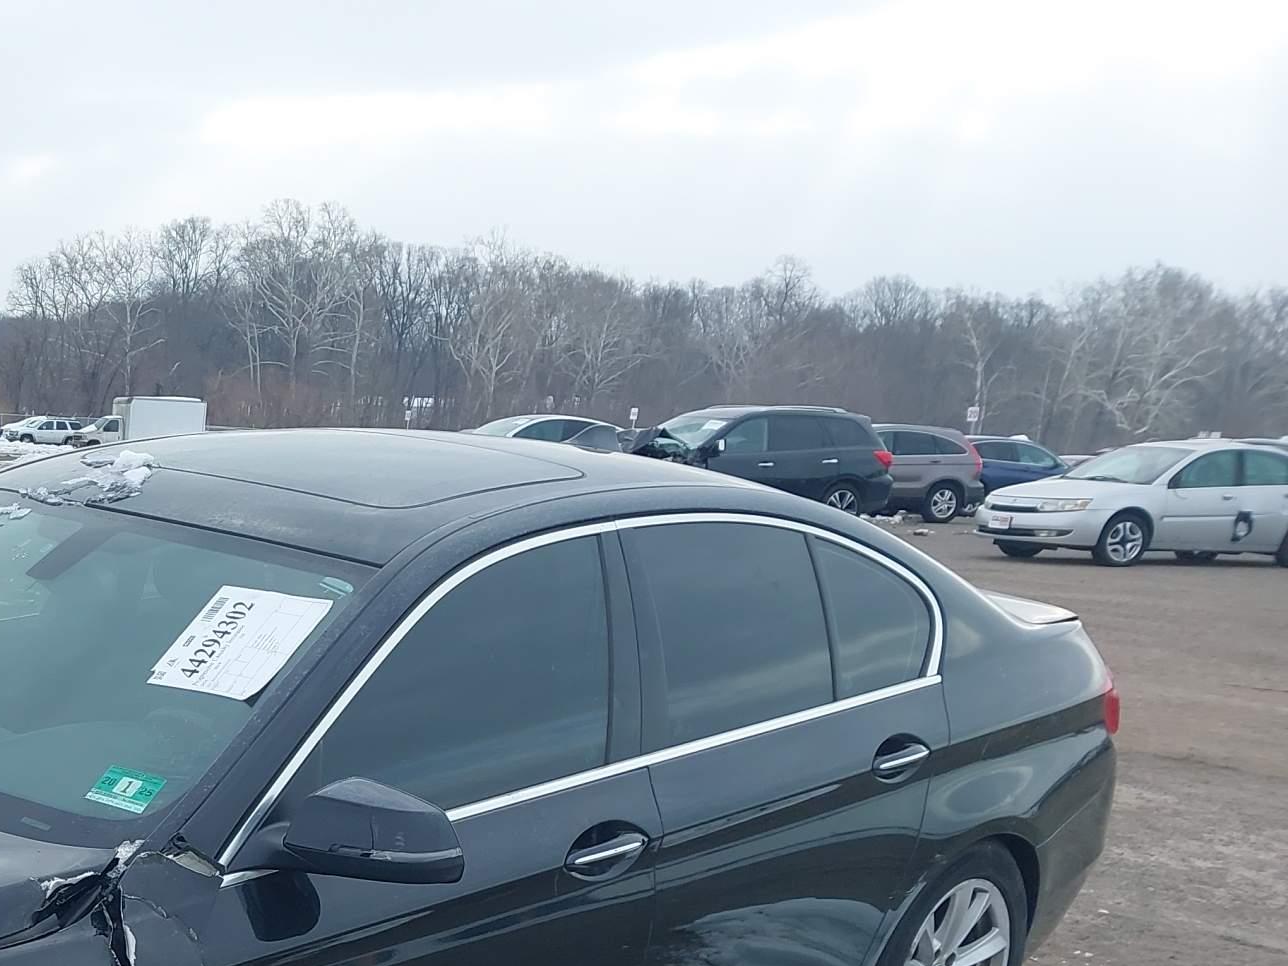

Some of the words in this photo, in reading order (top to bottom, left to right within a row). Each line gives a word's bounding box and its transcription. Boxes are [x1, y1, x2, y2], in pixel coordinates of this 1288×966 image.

[180, 601, 255, 679] 44294302
[101, 776, 117, 786] 20
[120, 780, 134, 794] 1
